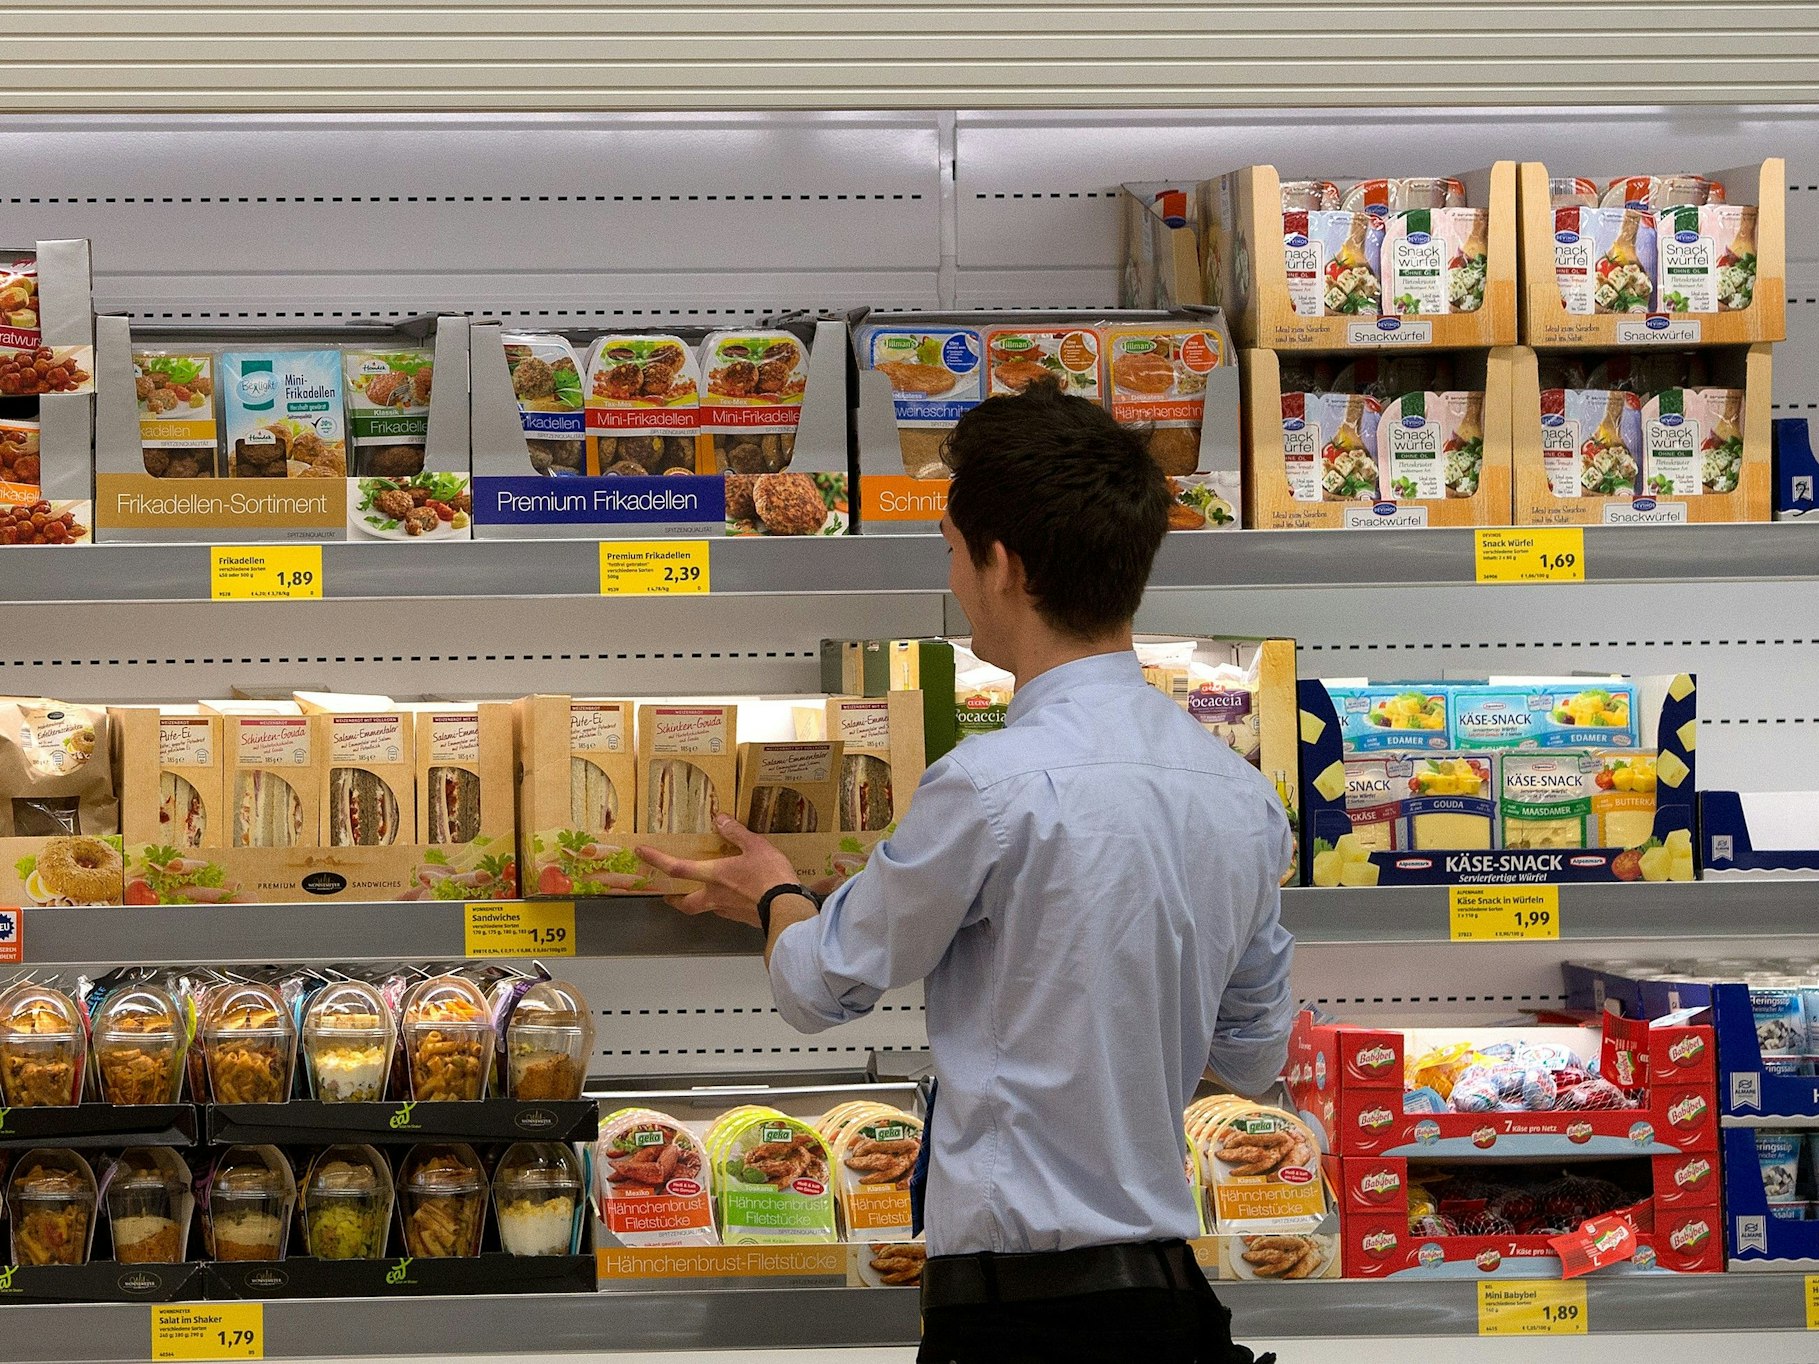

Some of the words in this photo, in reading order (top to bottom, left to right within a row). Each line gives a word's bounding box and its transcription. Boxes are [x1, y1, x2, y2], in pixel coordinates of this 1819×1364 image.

[1399, 246, 1439, 256] Snack
[1667, 244, 1708, 255] Snack
[1399, 257, 1440, 267] würfel
[1667, 256, 1708, 265] würfel
[1354, 330, 1425, 341] Snackwürfel
[1624, 330, 1694, 341] Snackwürfel
[885, 338, 916, 349] Tillman's
[1000, 338, 1032, 349] Tillman's
[285, 374, 307, 386] Mini-
[286, 387, 335, 399] Frikadellen
[597, 412, 694, 426] Mini-Frikadellen
[1394, 429, 1434, 440] Snack
[1651, 427, 1692, 438] Snack
[1394, 440, 1435, 450] würfel
[1651, 437, 1693, 448] würfel
[117, 494, 327, 514] Frikadellen-Sortiment
[497, 492, 586, 511] Premium
[594, 490, 697, 510] Frikadellen
[1351, 516, 1421, 526] Snackwürfel
[1610, 512, 1680, 522] Snackwürfel
[1540, 554, 1575, 570] 1,69
[277, 572, 313, 588] 1,89
[664, 567, 700, 583] 2,39
[1459, 711, 1532, 726] KÄSE-SNACK
[656, 717, 721, 734] Schinken-Gouda
[241, 727, 306, 746] Schinken-Gouda
[333, 726, 398, 743] Salami-Emmentaler
[1571, 734, 1607, 742] EDAMER
[1507, 774, 1582, 786] KÄSE-SNACK
[1433, 800, 1464, 809] GOUDA
[1522, 806, 1571, 816] MAASDAMER
[1446, 853, 1563, 872] KÄSE-SNACK
[1459, 873, 1516, 883] Servierfertige
[1519, 872, 1547, 882] Würfel
[1504, 896, 1510, 904] in
[1513, 896, 1544, 904] Würfeln
[1515, 912, 1550, 928] 1,99
[530, 928, 566, 945] 1,59
[1672, 1038, 1701, 1060] Babybel
[1359, 1050, 1392, 1064] Babybel
[389, 1102, 416, 1129] eat
[1671, 1098, 1702, 1122] Babybel
[1360, 1112, 1392, 1125] Babybel
[1250, 1121, 1271, 1131] geka
[1504, 1121, 1512, 1132] 7
[638, 1133, 661, 1143] geka
[766, 1130, 790, 1140] geka
[879, 1129, 900, 1138] geka
[1677, 1160, 1707, 1182] Babybel
[1364, 1175, 1396, 1189] Babybel
[1220, 1187, 1318, 1202] Hähnchenbrust-
[608, 1199, 705, 1215] Hähnchenbrust-
[729, 1194, 828, 1212] Hähnchenbrust-
[1238, 1203, 1303, 1217] Filetstücke
[625, 1216, 690, 1229] Filetstücke
[746, 1211, 811, 1226] Filetstücke
[1365, 1234, 1395, 1248] Babybel
[1673, 1224, 1705, 1247] Babybel
[1509, 1243, 1516, 1256] 7
[607, 1253, 837, 1273] Hähnchenbrust-Filetstücke
[386, 1258, 413, 1285] eat
[1504, 1291, 1536, 1300] Babybel
[1543, 1306, 1578, 1322] 1,89
[218, 1330, 254, 1348] 1,79
